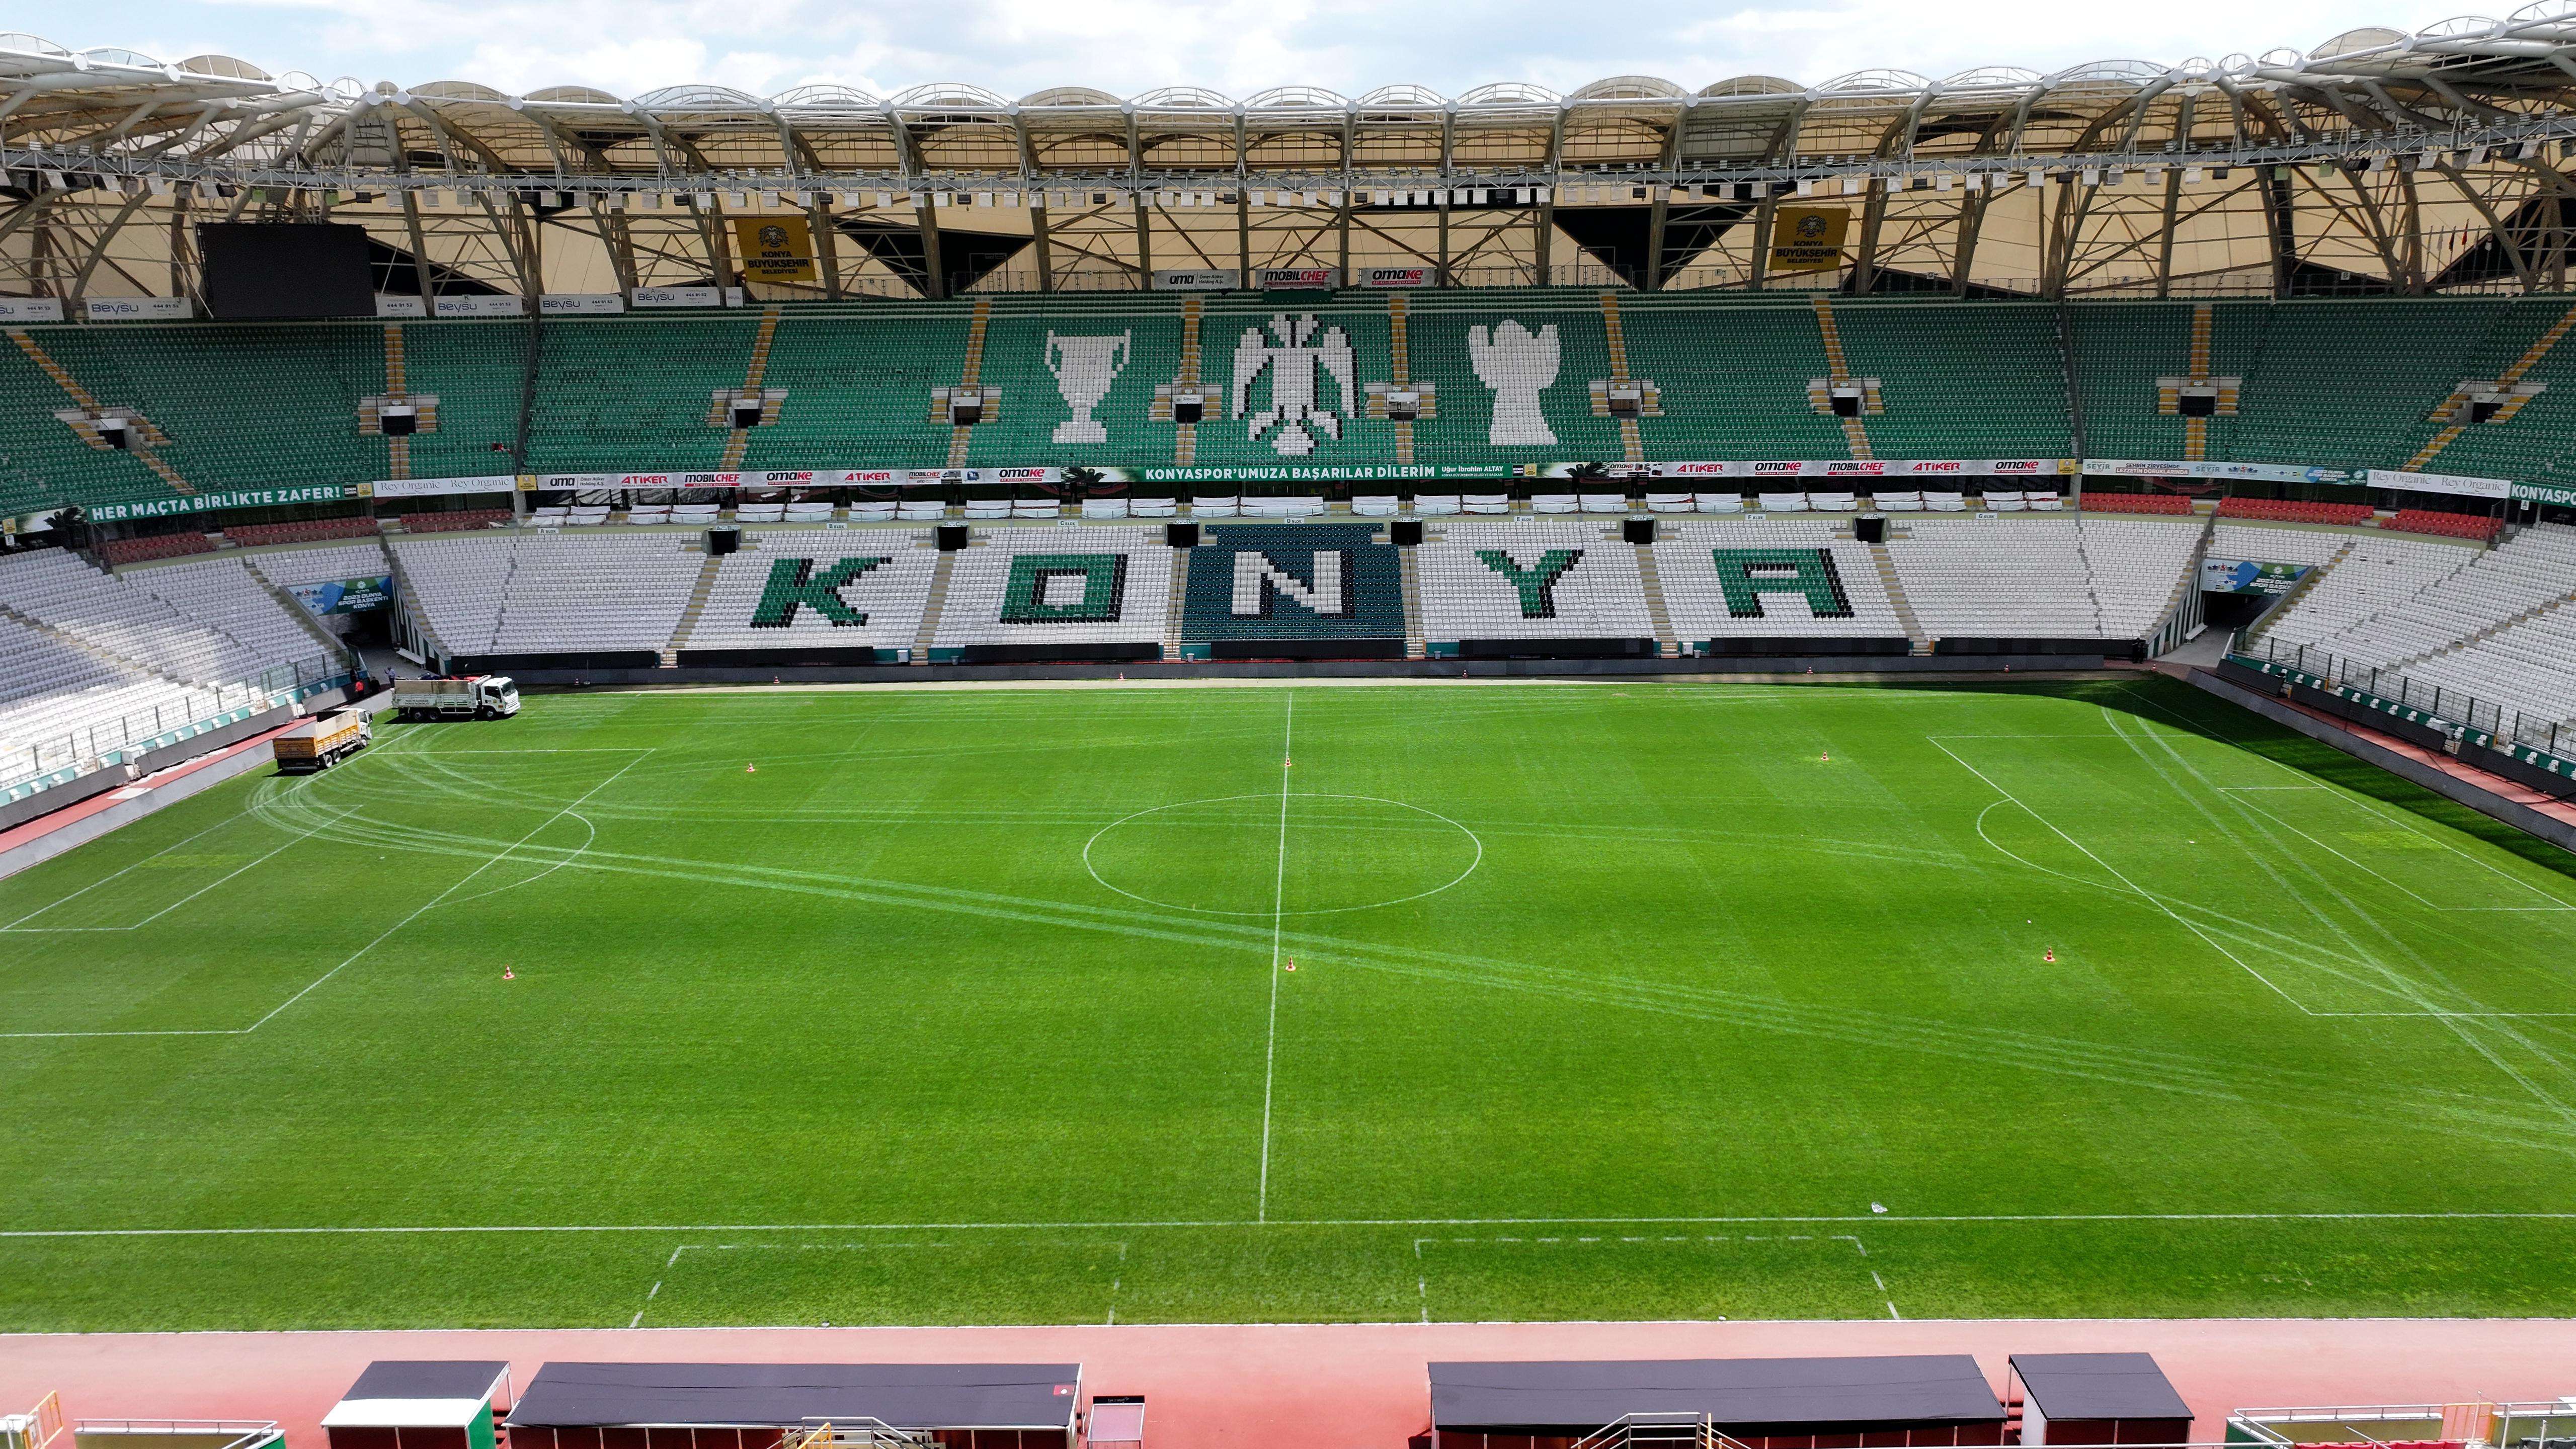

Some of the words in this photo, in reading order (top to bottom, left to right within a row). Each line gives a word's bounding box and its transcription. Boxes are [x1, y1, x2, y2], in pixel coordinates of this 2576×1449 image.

[1372, 270, 1423, 279] omake
[1755, 462, 1802, 471] omake
[1995, 461, 2038, 469] omake
[766, 471, 813, 480] omake
[999, 469, 1045, 477] omake
[1292, 466, 1373, 480] BAŞARILAR
[1377, 464, 1435, 477] DİLERİM
[381, 482, 399, 492] Rey
[402, 481, 441, 492] Organic
[451, 479, 469, 489] Rey
[471, 477, 510, 489] Organic
[2372, 471, 2392, 482] Rey
[2393, 473, 2431, 486] Organic
[2441, 476, 2461, 488] Rey
[2463, 478, 2504, 492] Organic
[92, 505, 127, 521] HER
[131, 499, 190, 516] MAÇTA
[194, 491, 273, 510] BİRLİKTE
[277, 486, 341, 502] ZAFER!
